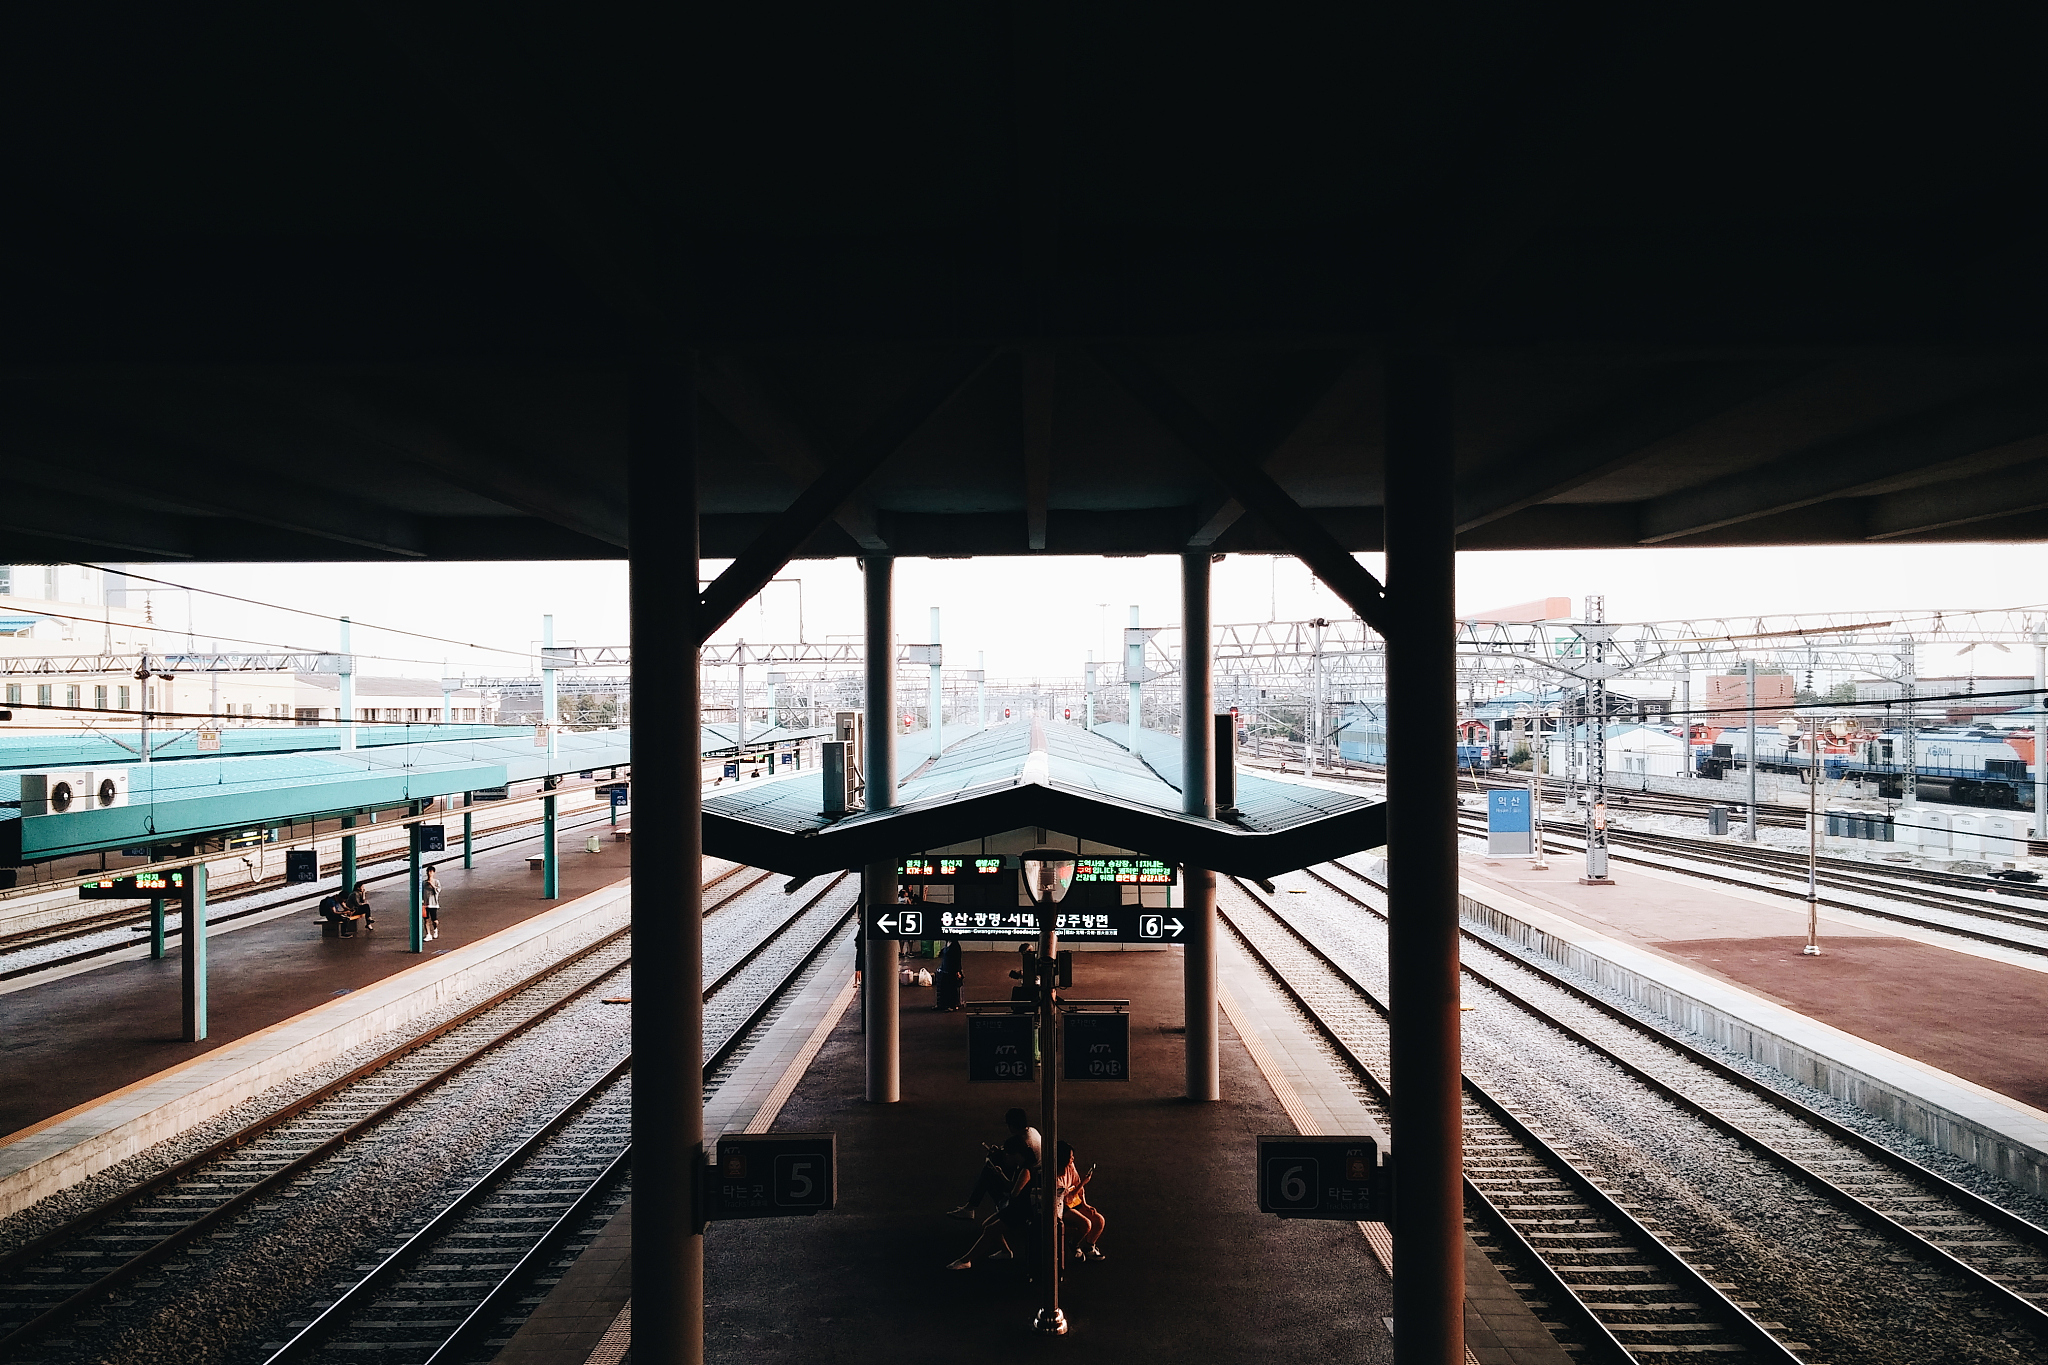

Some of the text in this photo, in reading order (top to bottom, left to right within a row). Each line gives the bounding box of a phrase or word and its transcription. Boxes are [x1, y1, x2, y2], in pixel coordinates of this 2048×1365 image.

[1928, 745, 1952, 756] KORAIL
[905, 914, 917, 932] 5
[1146, 917, 1158, 935] 6
[790, 1162, 812, 1198] 5
[1281, 1165, 1306, 1201] 6
[723, 1185, 763, 1198] 타는 곳
[1328, 1187, 1369, 1201] 타는 곳
